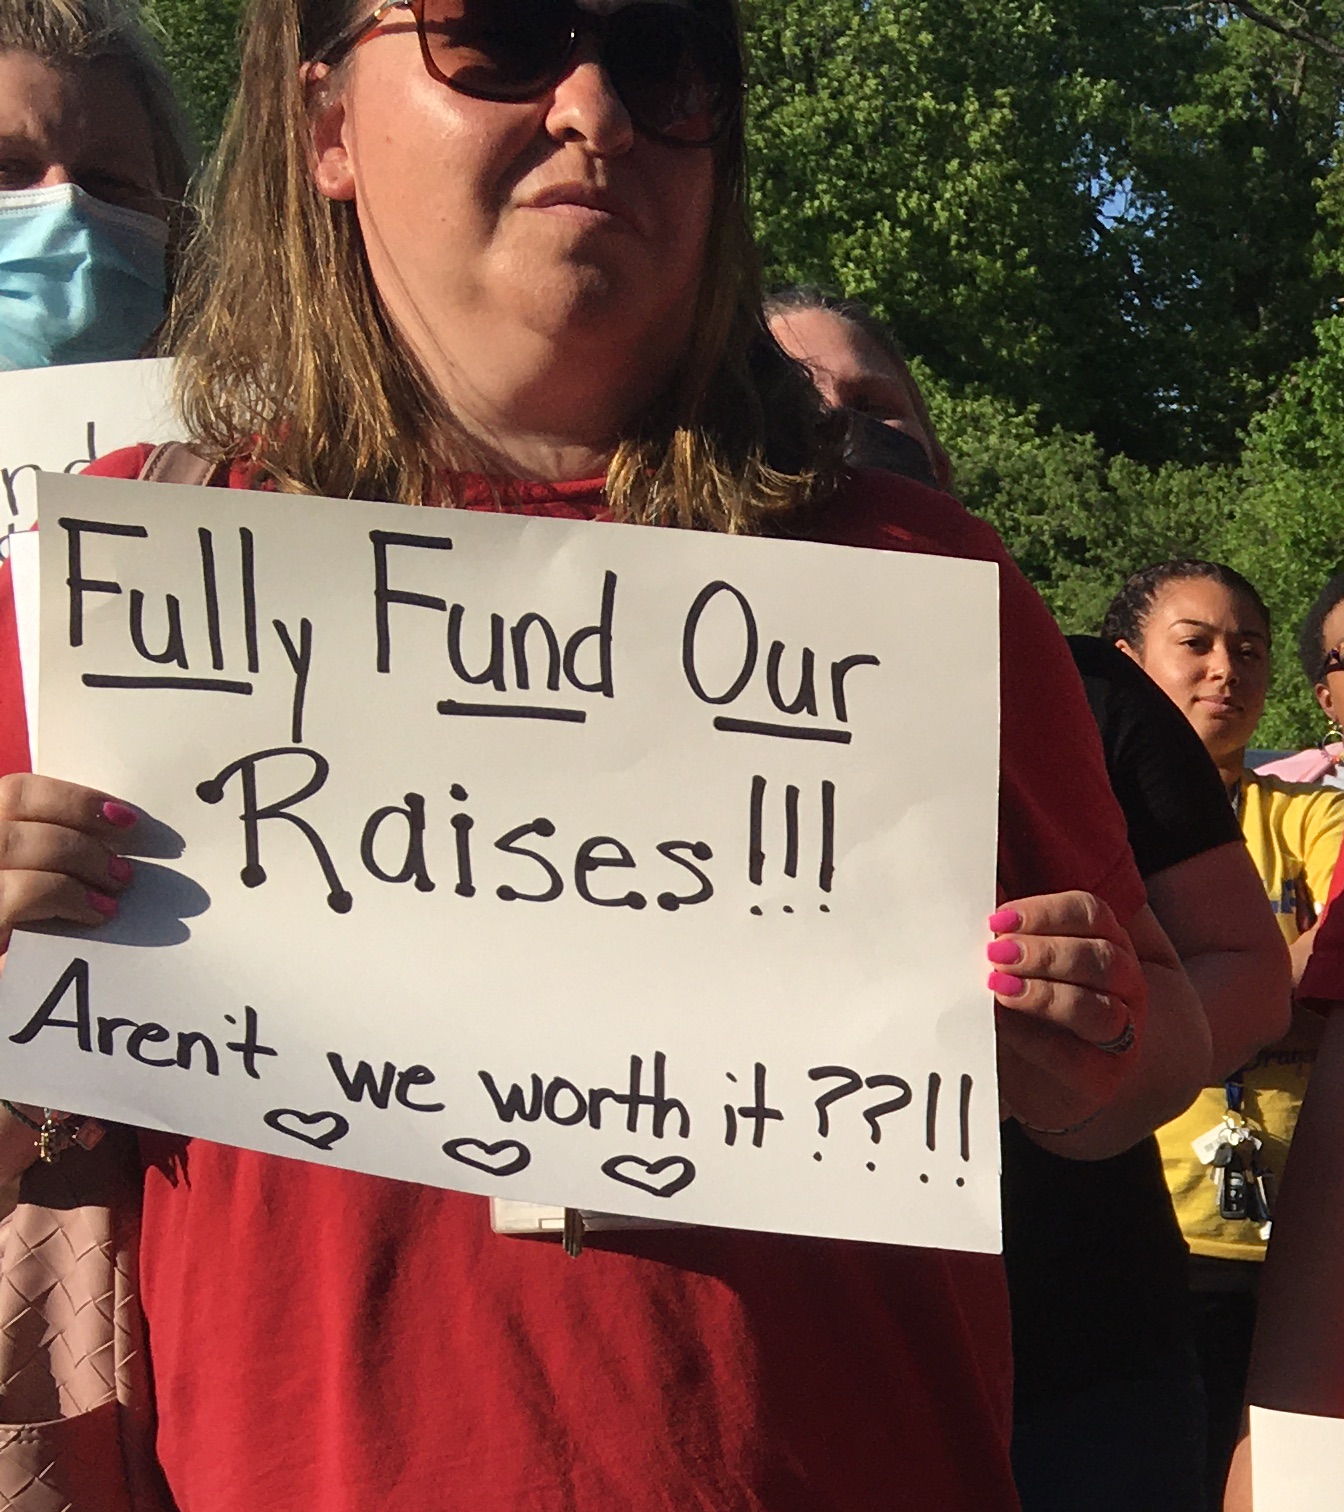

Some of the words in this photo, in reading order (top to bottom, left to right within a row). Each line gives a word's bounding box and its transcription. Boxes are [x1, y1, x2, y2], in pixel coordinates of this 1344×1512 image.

[58, 518, 313, 743] Fully
[369, 527, 616, 698] Fund
[683, 581, 880, 724] Our
[196, 746, 837, 916] Raises!!!
[9, 958, 277, 1079] Aren't
[327, 1051, 446, 1112] we
[478, 1051, 690, 1140] worth
